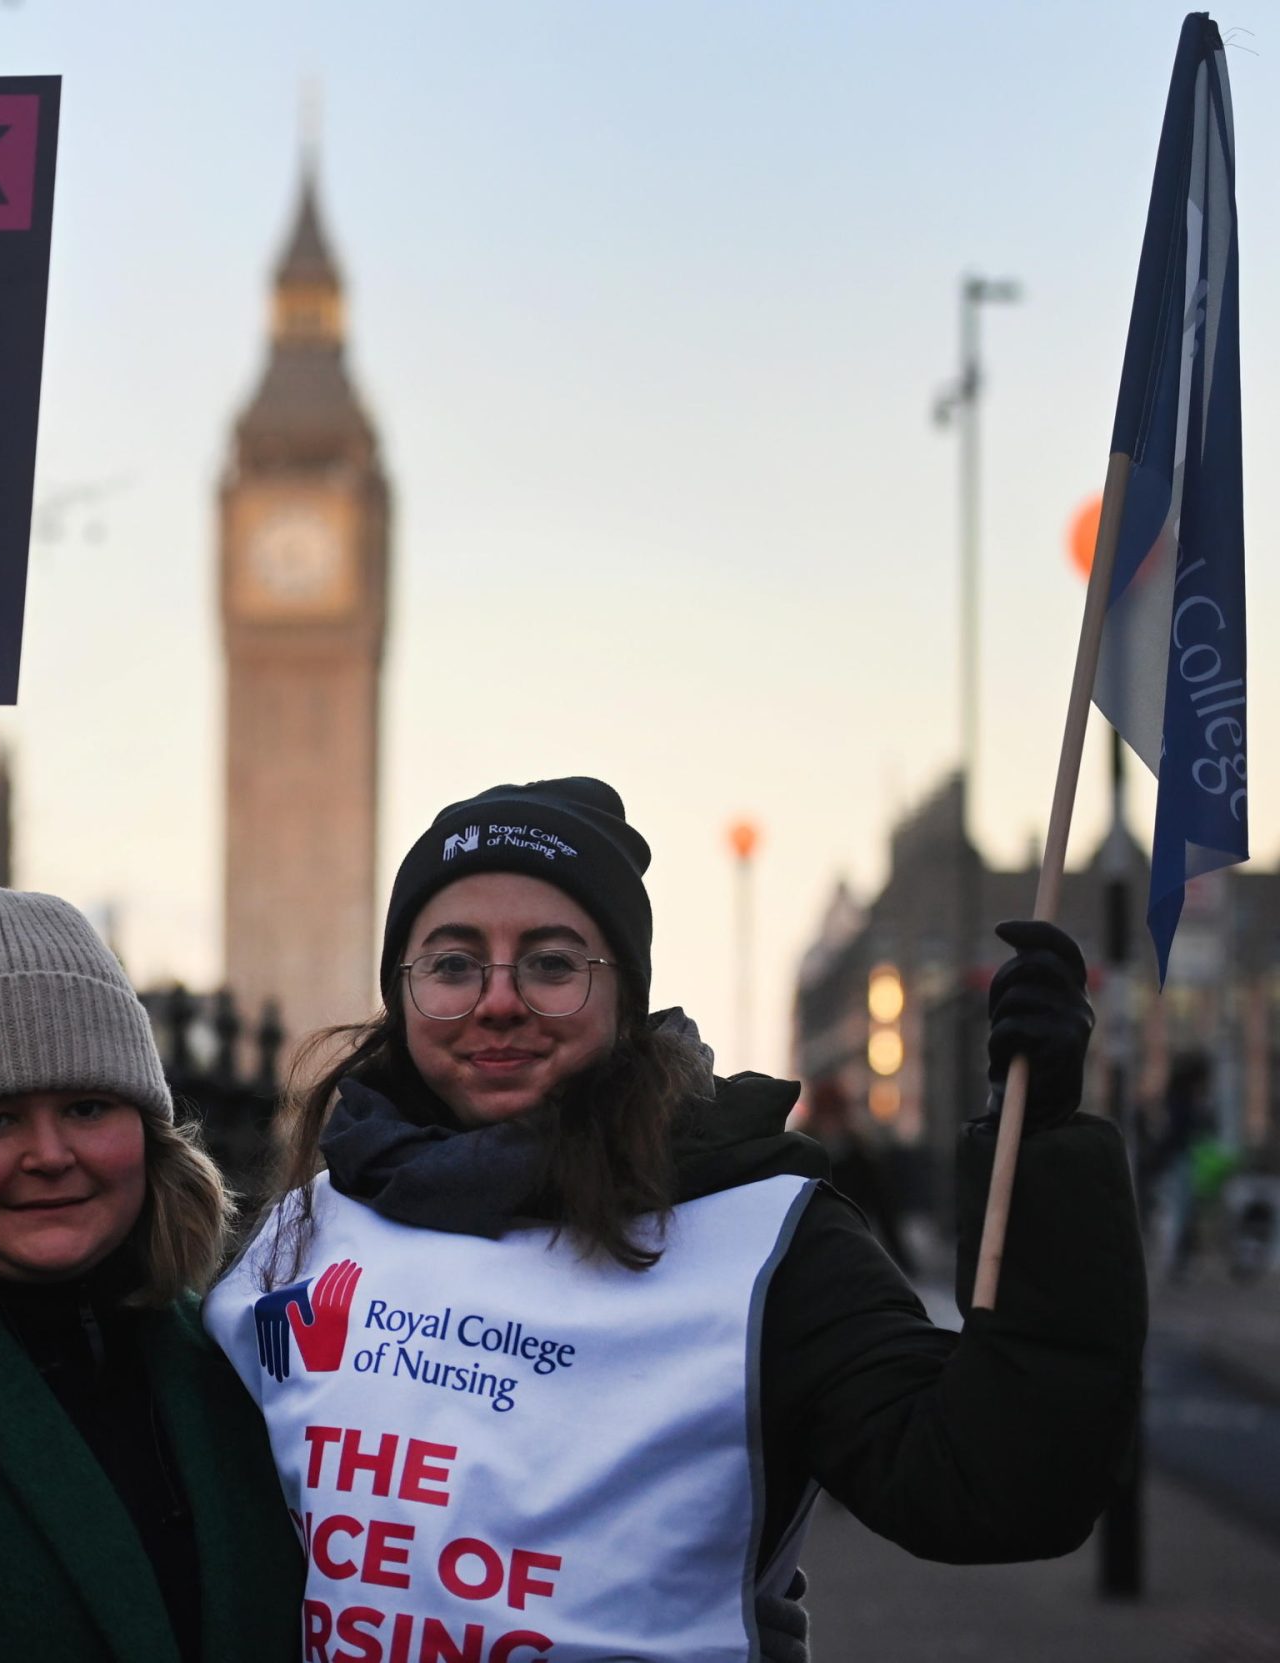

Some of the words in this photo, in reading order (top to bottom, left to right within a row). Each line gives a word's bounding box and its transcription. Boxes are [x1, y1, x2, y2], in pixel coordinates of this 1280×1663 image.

[486, 834, 503, 846] of
[503, 834, 556, 860] Nursing
[488, 824, 528, 835] Royal
[529, 828, 578, 858] College
[364, 1300, 451, 1344] Royal
[457, 1314, 576, 1375] College
[353, 1342, 391, 1374] of
[393, 1346, 519, 1413] Nursing
[304, 1425, 458, 1507] THE
[437, 1537, 563, 1611] OF
[302, 1599, 555, 1663] RSING
